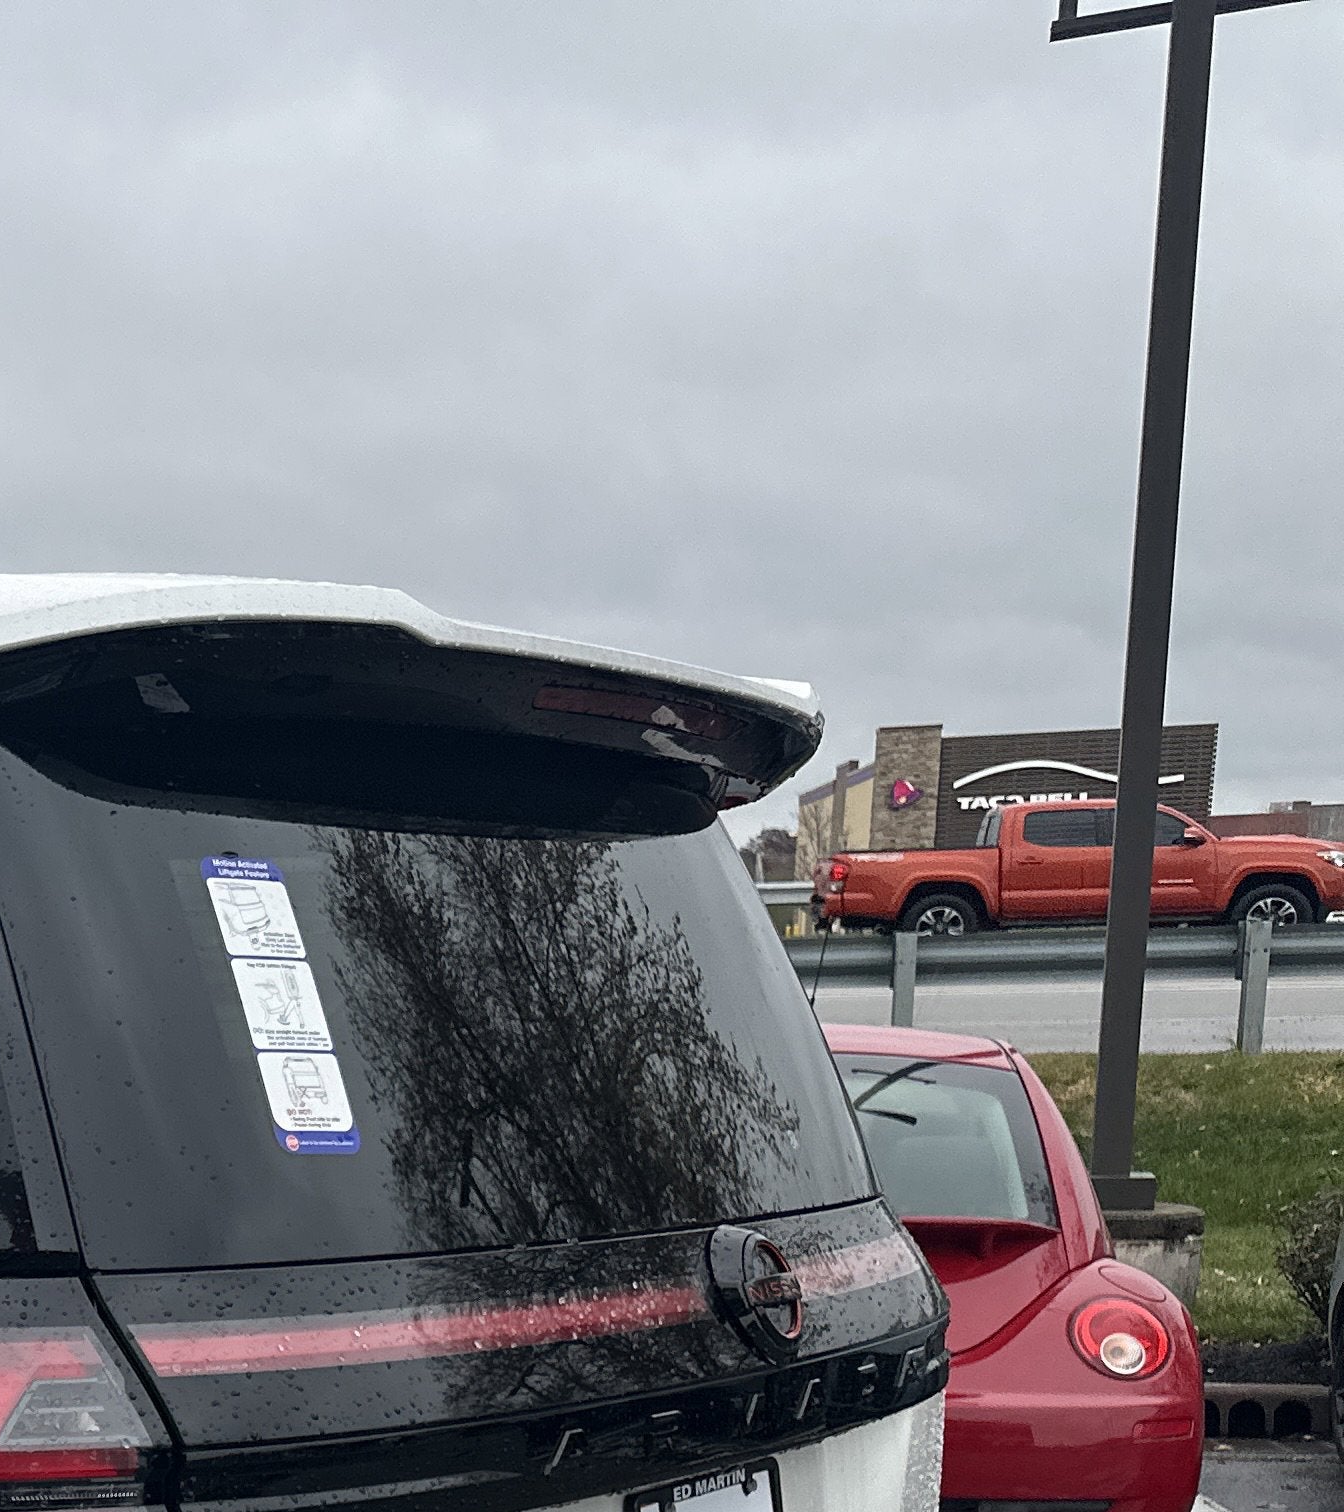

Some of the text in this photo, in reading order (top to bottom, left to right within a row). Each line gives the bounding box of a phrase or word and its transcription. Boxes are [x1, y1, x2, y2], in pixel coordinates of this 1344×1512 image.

[957, 795, 1024, 810] TACO
[673, 1468, 746, 1501] ED MARTIN
